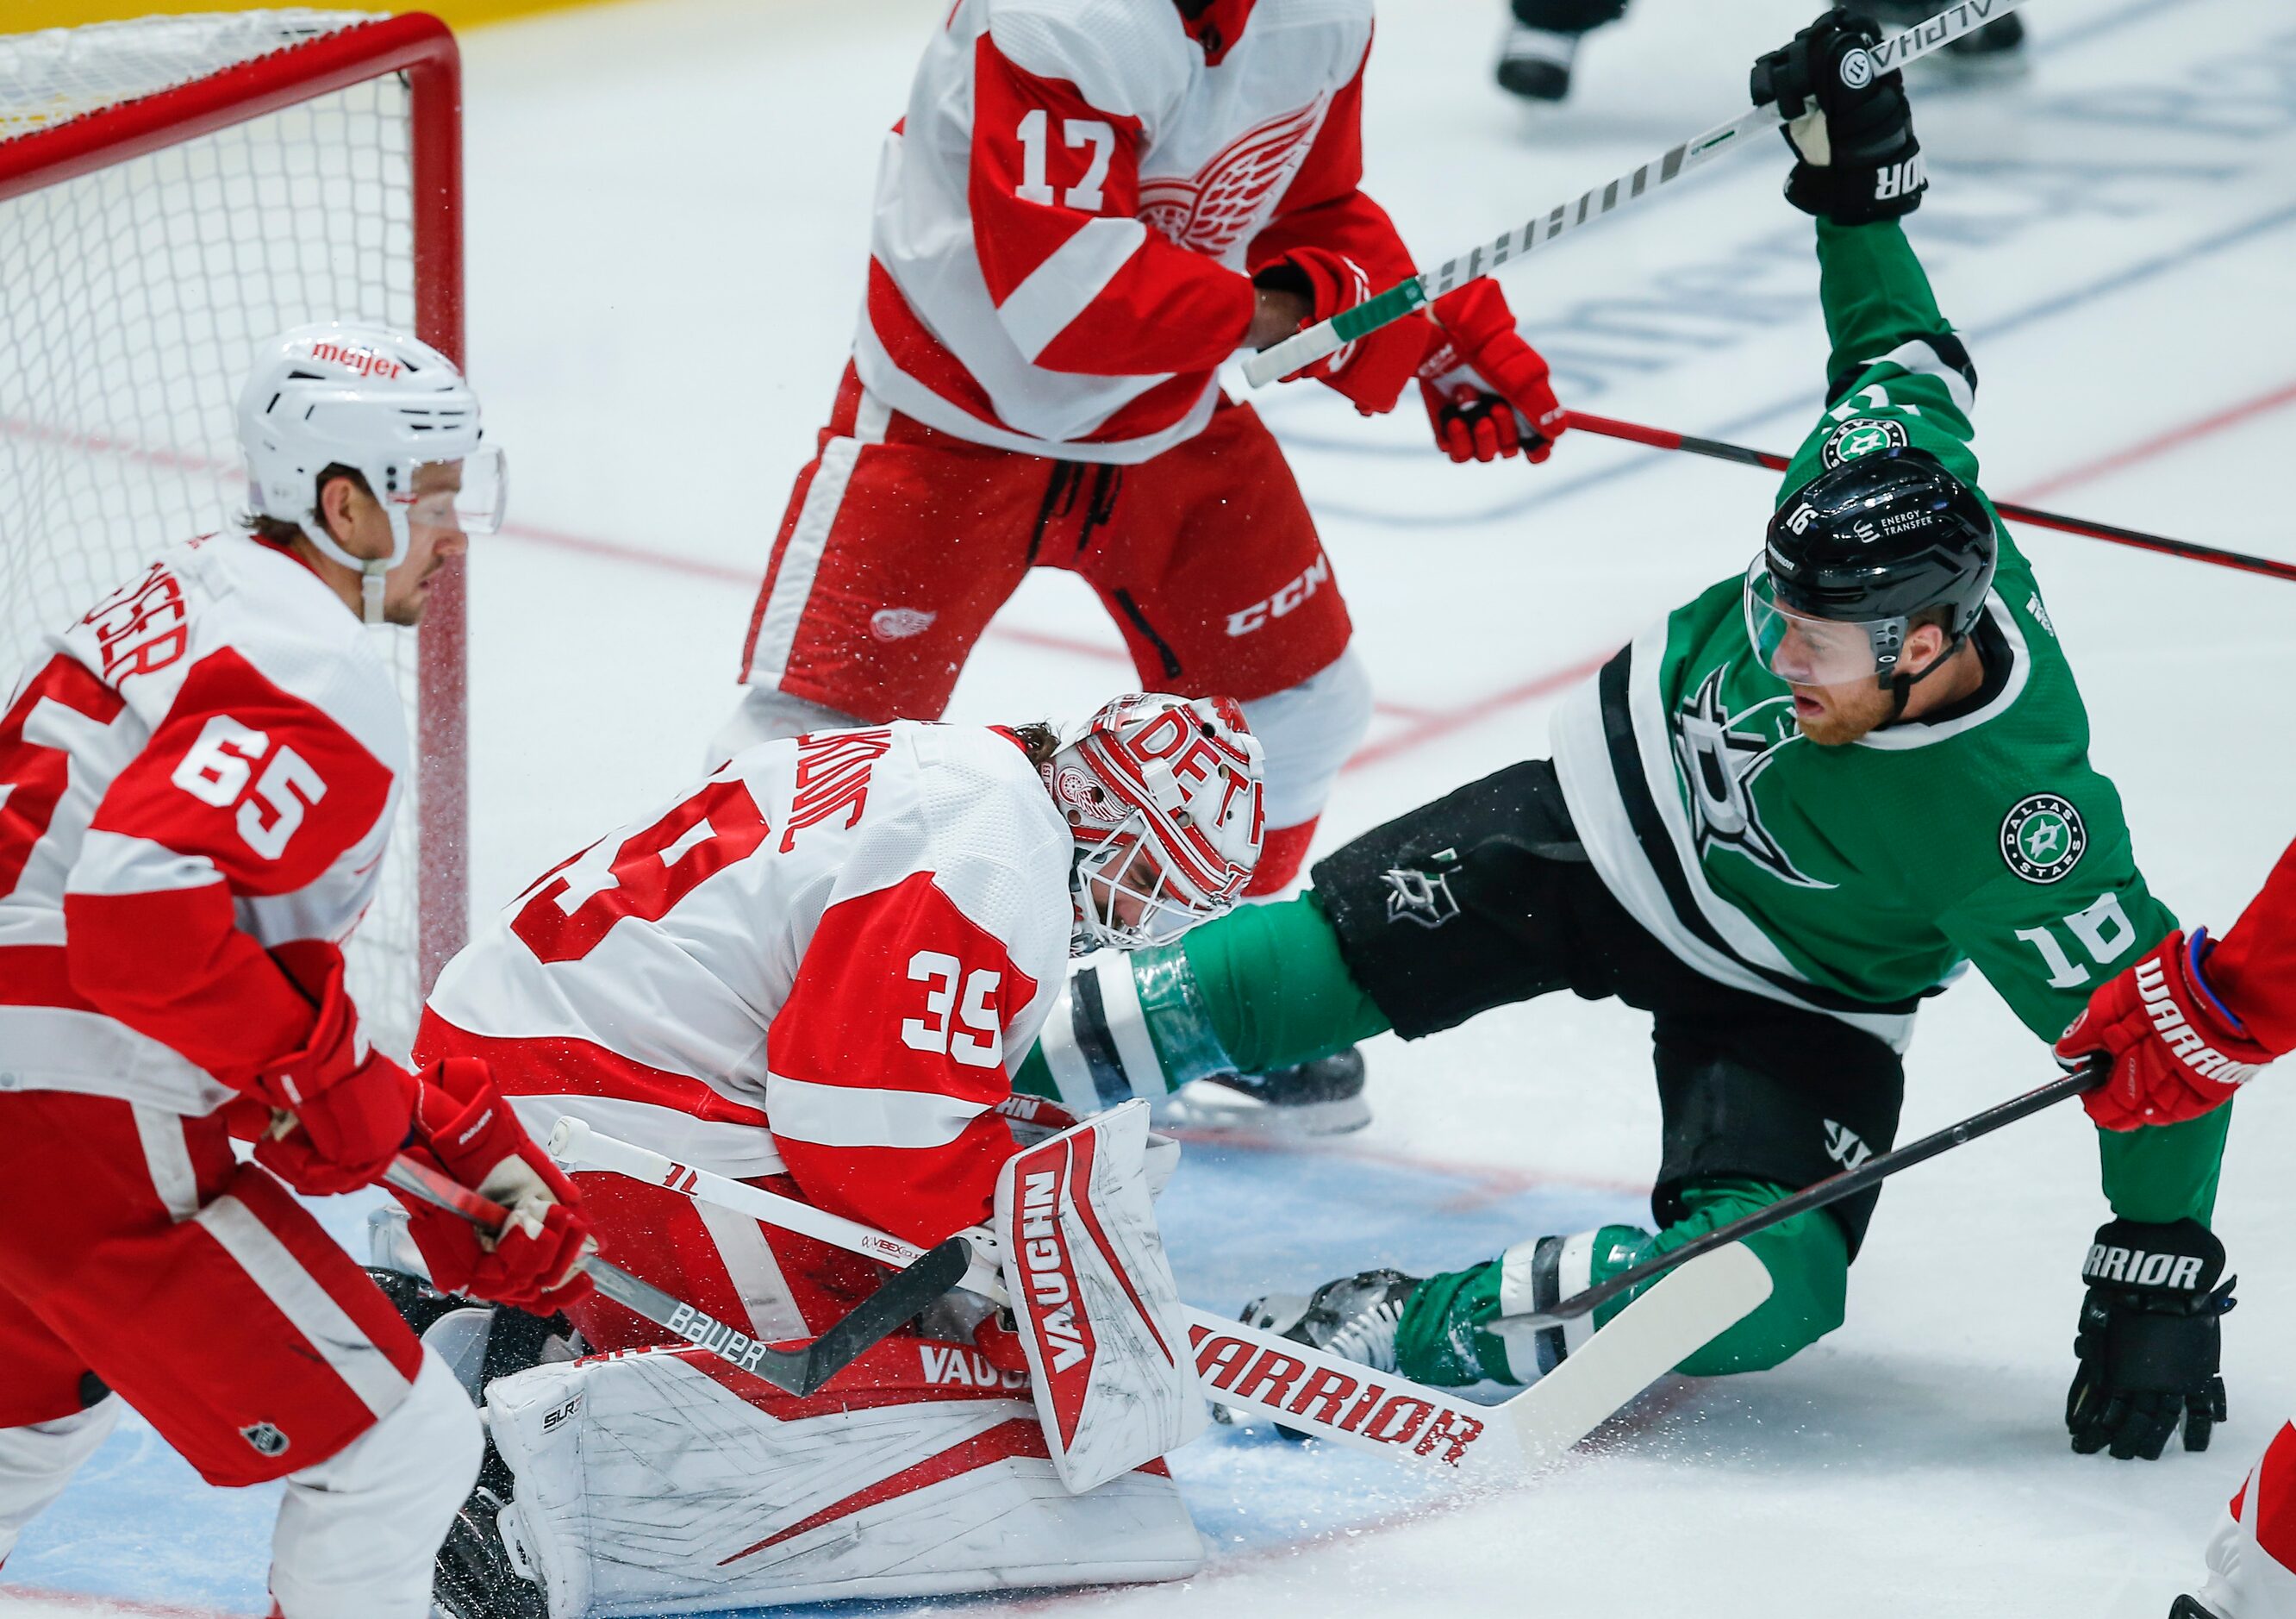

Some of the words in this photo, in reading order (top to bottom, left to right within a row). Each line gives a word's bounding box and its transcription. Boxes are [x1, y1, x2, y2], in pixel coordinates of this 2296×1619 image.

[1870, 0, 1994, 67] ALPHA
[1015, 109, 1115, 211] 17
[313, 343, 401, 379] meijer
[1786, 502, 1819, 536] 16
[1881, 509, 1920, 528] ENERGY
[1883, 516, 1933, 536] TRANSFER
[1226, 553, 1328, 636] CCM
[171, 714, 328, 860] 65
[2006, 800, 2073, 845] DALLAS
[2019, 840, 2081, 878] STARS
[902, 950, 1003, 1069] 39
[1023, 1171, 1087, 1374] VAUGHN
[664, 1302, 767, 1372] BAUER
